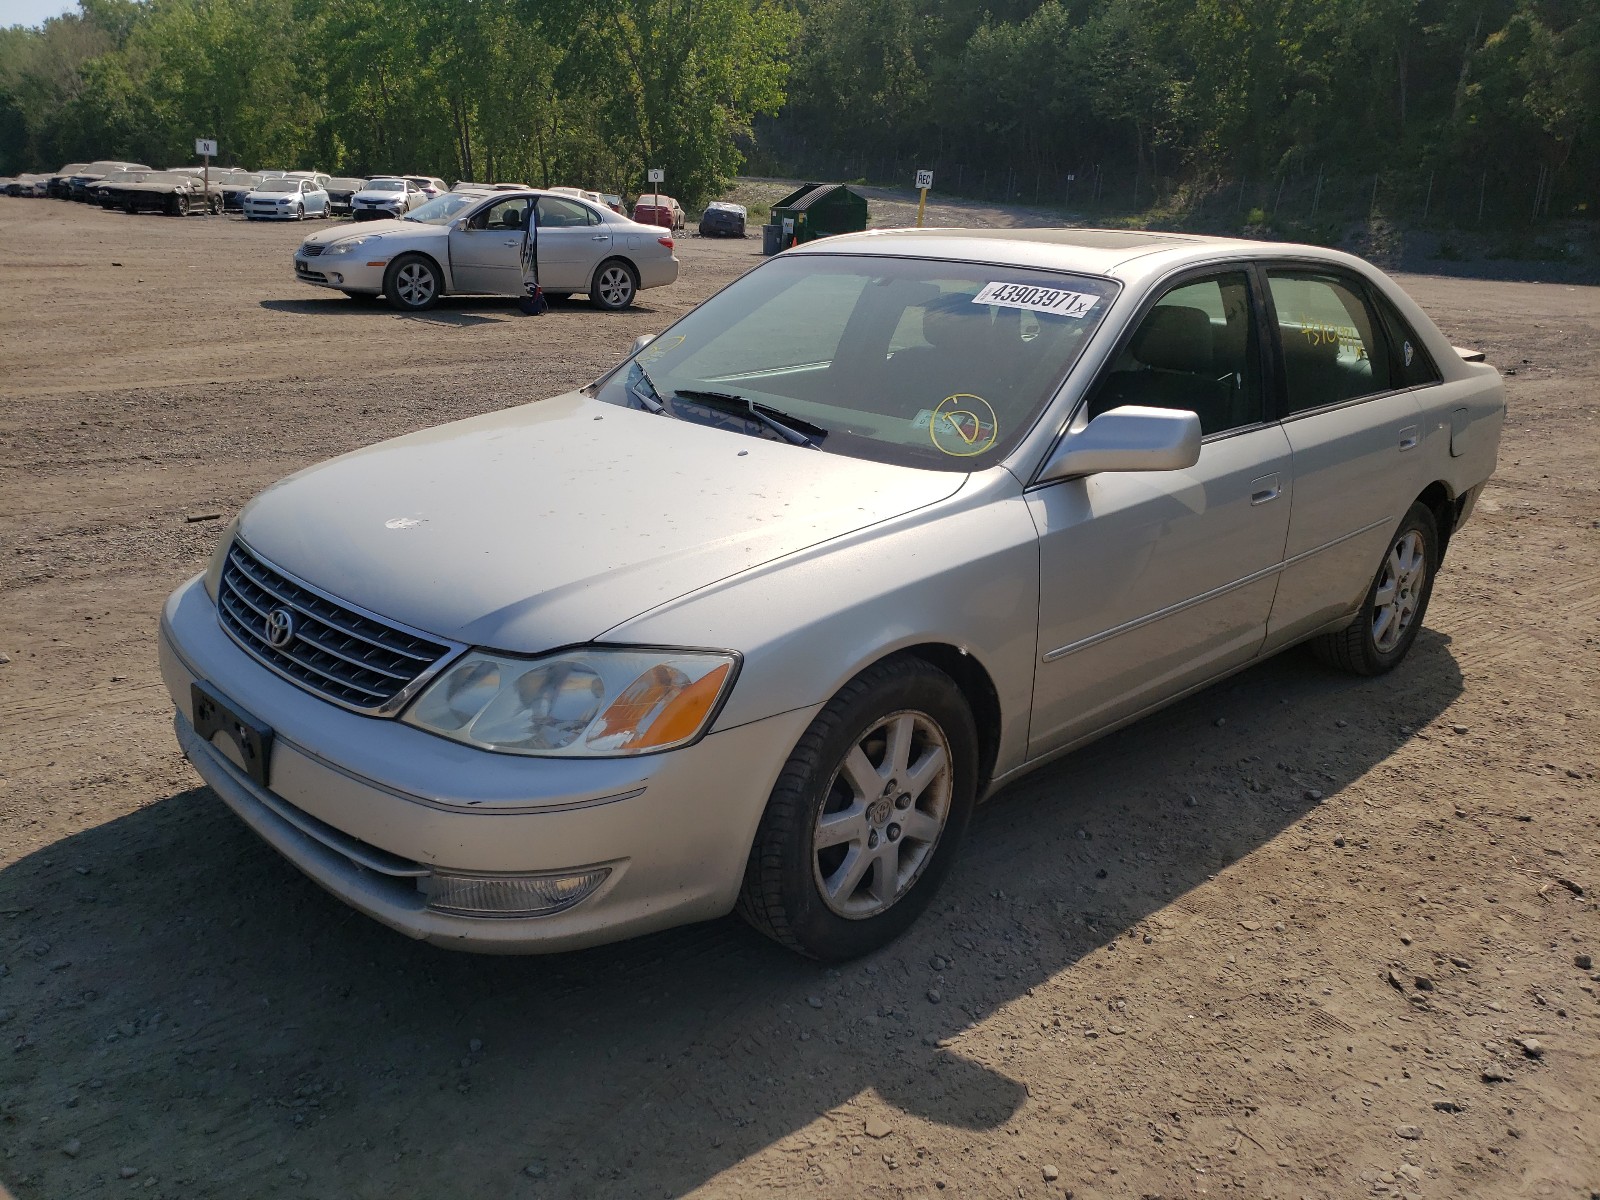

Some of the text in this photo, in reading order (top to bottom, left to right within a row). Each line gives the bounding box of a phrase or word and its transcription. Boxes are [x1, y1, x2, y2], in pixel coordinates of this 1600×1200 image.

[203, 142, 209, 151] N
[918, 174, 930, 184] REC
[991, 284, 1082, 311] 43903971
